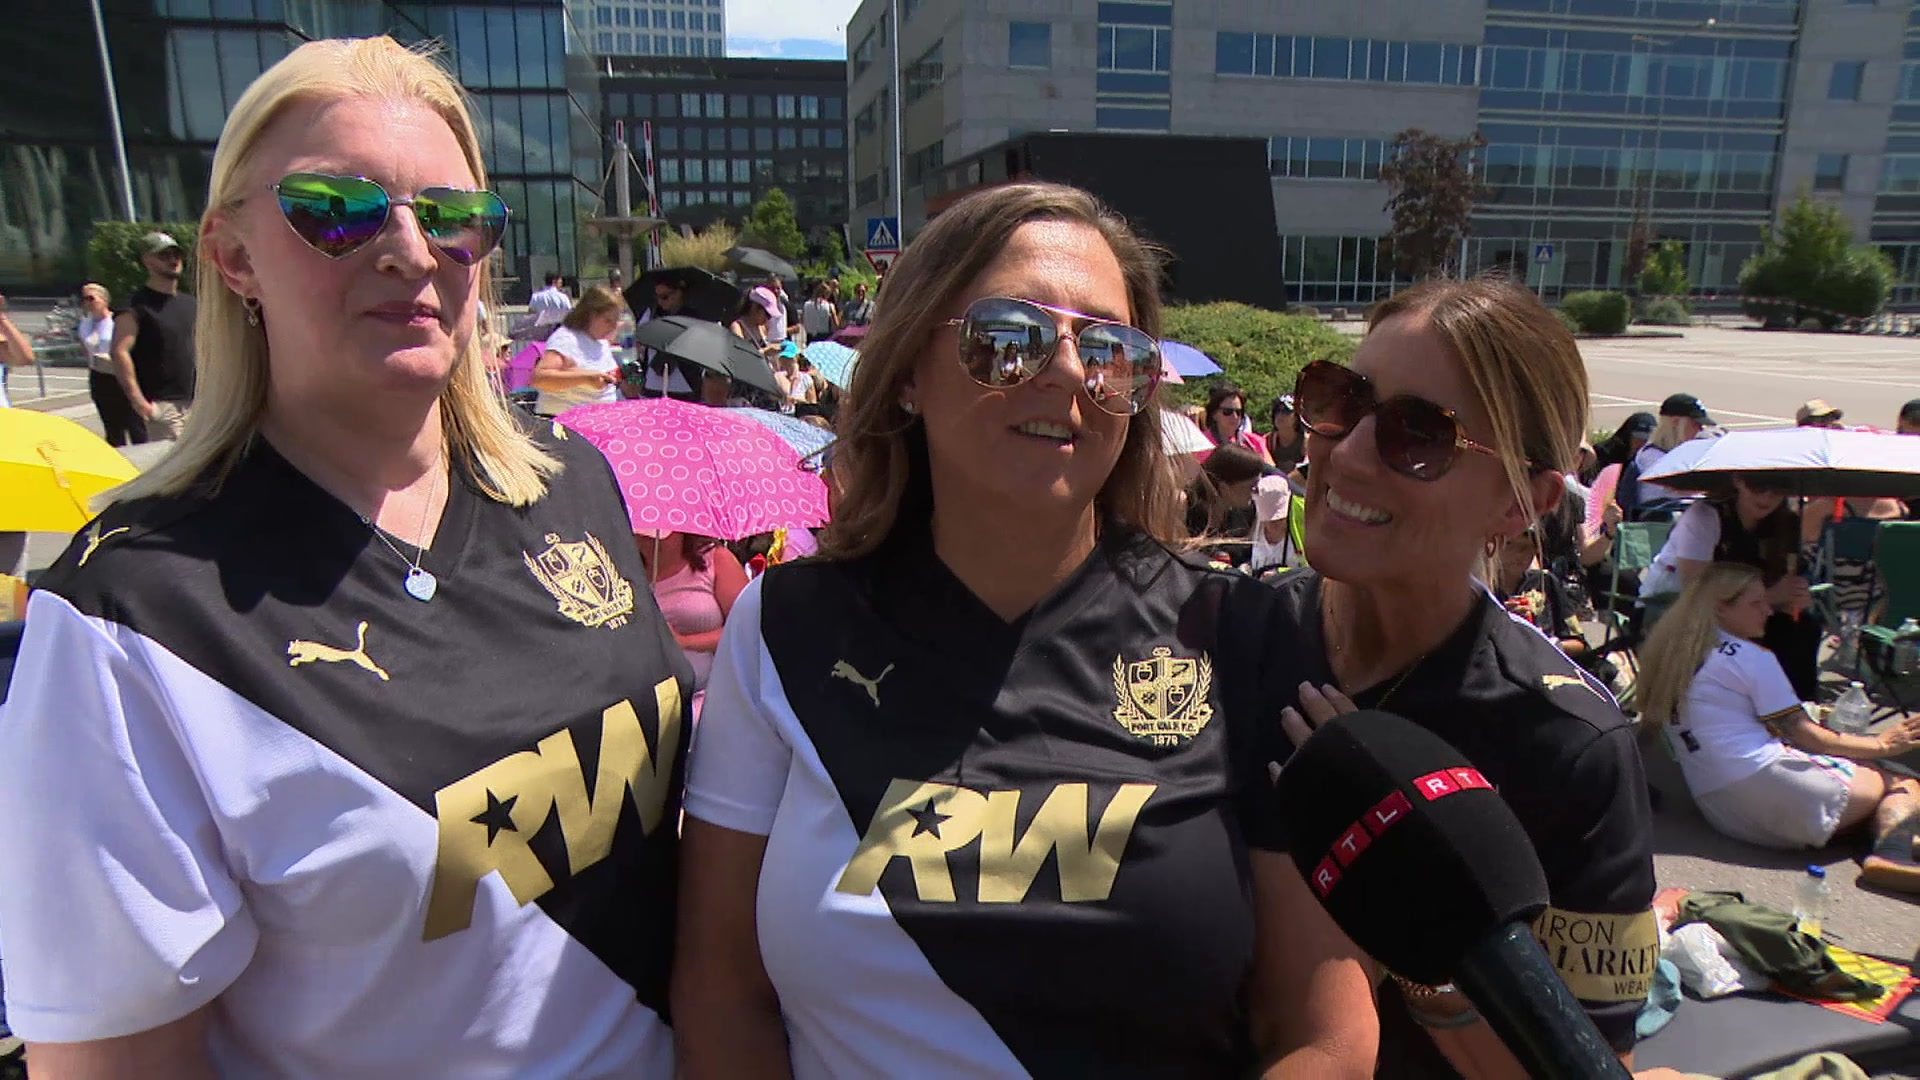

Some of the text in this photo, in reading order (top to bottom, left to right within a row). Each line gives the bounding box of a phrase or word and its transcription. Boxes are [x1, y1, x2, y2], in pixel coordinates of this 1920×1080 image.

[422, 675, 683, 943] RW
[1425, 771, 1493, 795] RT
[835, 777, 1158, 903] RW
[1317, 808, 1398, 890] RTL
[1540, 914, 1615, 946] IRON
